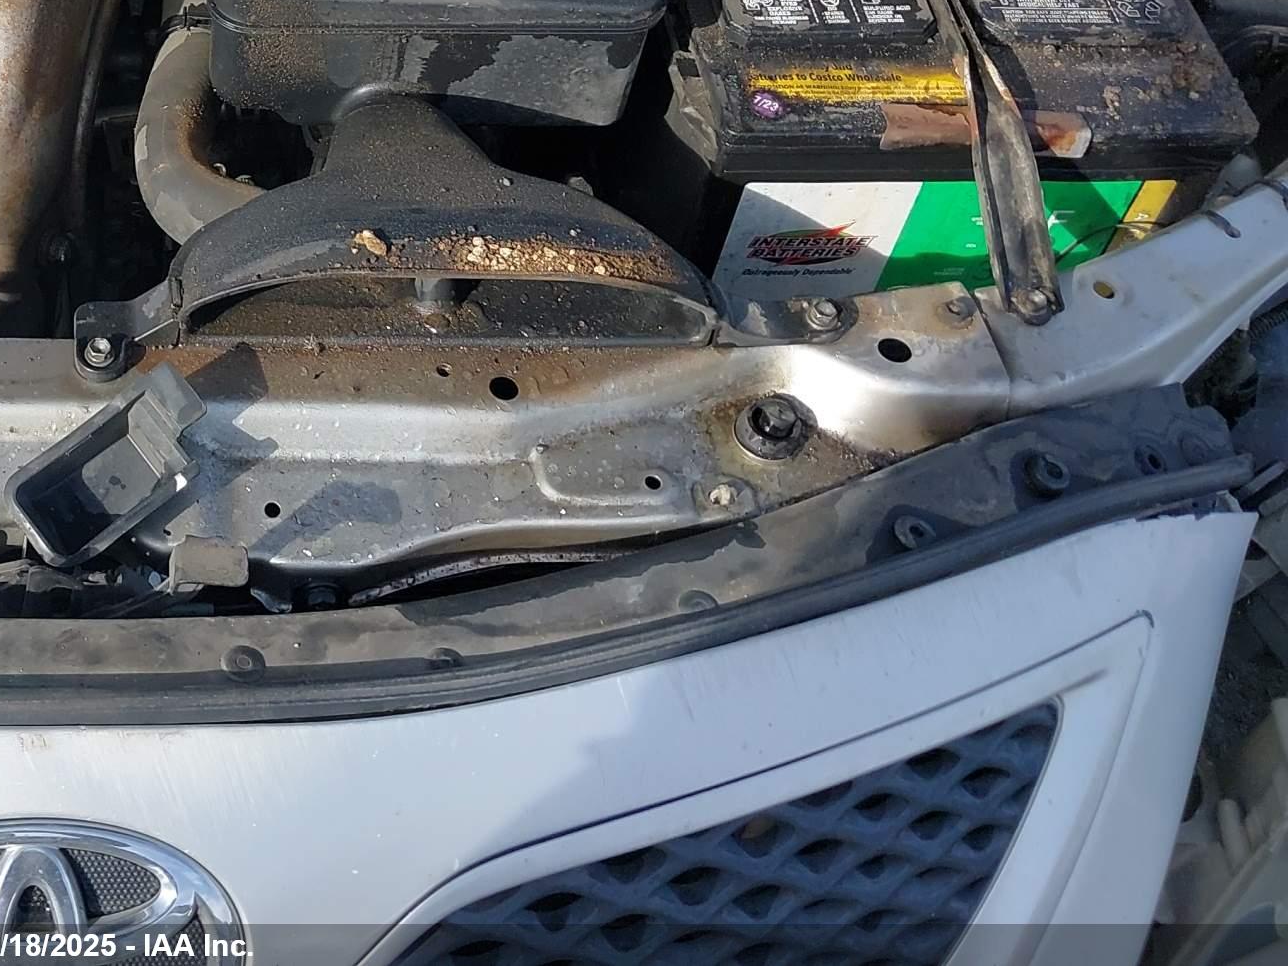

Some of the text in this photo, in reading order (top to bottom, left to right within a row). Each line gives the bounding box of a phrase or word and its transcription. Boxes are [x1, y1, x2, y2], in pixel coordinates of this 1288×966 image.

[797, 73, 808, 81] to
[809, 72, 844, 82] Costco
[845, 72, 902, 82] Wholesale
[752, 94, 780, 112] 7/23
[747, 236, 870, 248] INTERSTATE
[747, 248, 860, 258] BATTERIES
[742, 268, 853, 277] Outrageously Dependable
